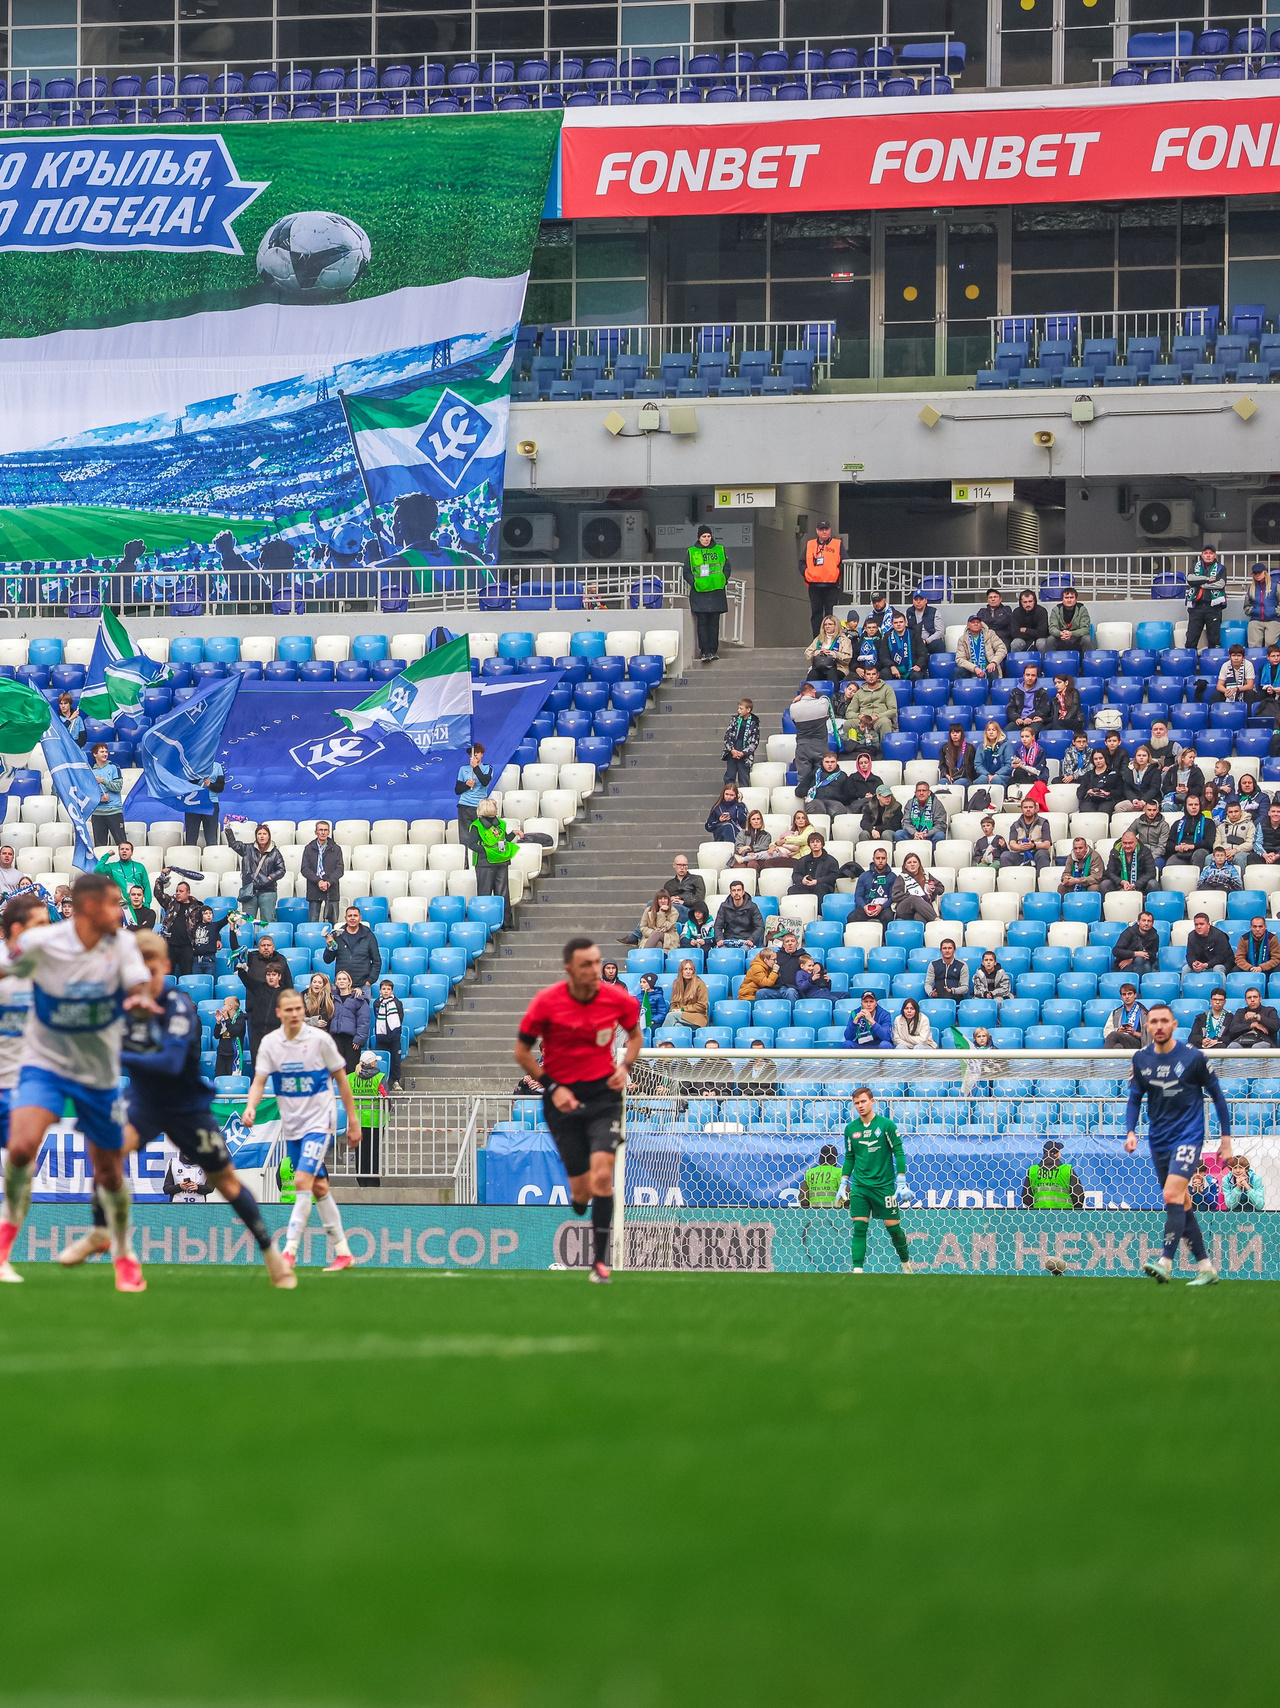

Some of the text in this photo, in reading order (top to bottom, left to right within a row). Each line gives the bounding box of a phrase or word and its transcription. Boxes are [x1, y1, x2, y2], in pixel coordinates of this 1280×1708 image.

[31, 150, 212, 191] КРЫЛЬЯ,
[595, 144, 820, 195] FONBET
[869, 132, 1100, 185] FONBET
[23, 195, 216, 238] ПОБЕДА!
[735, 492, 754, 504] 115
[973, 487, 991, 499] 114
[1175, 1145, 1197, 1164] 23
